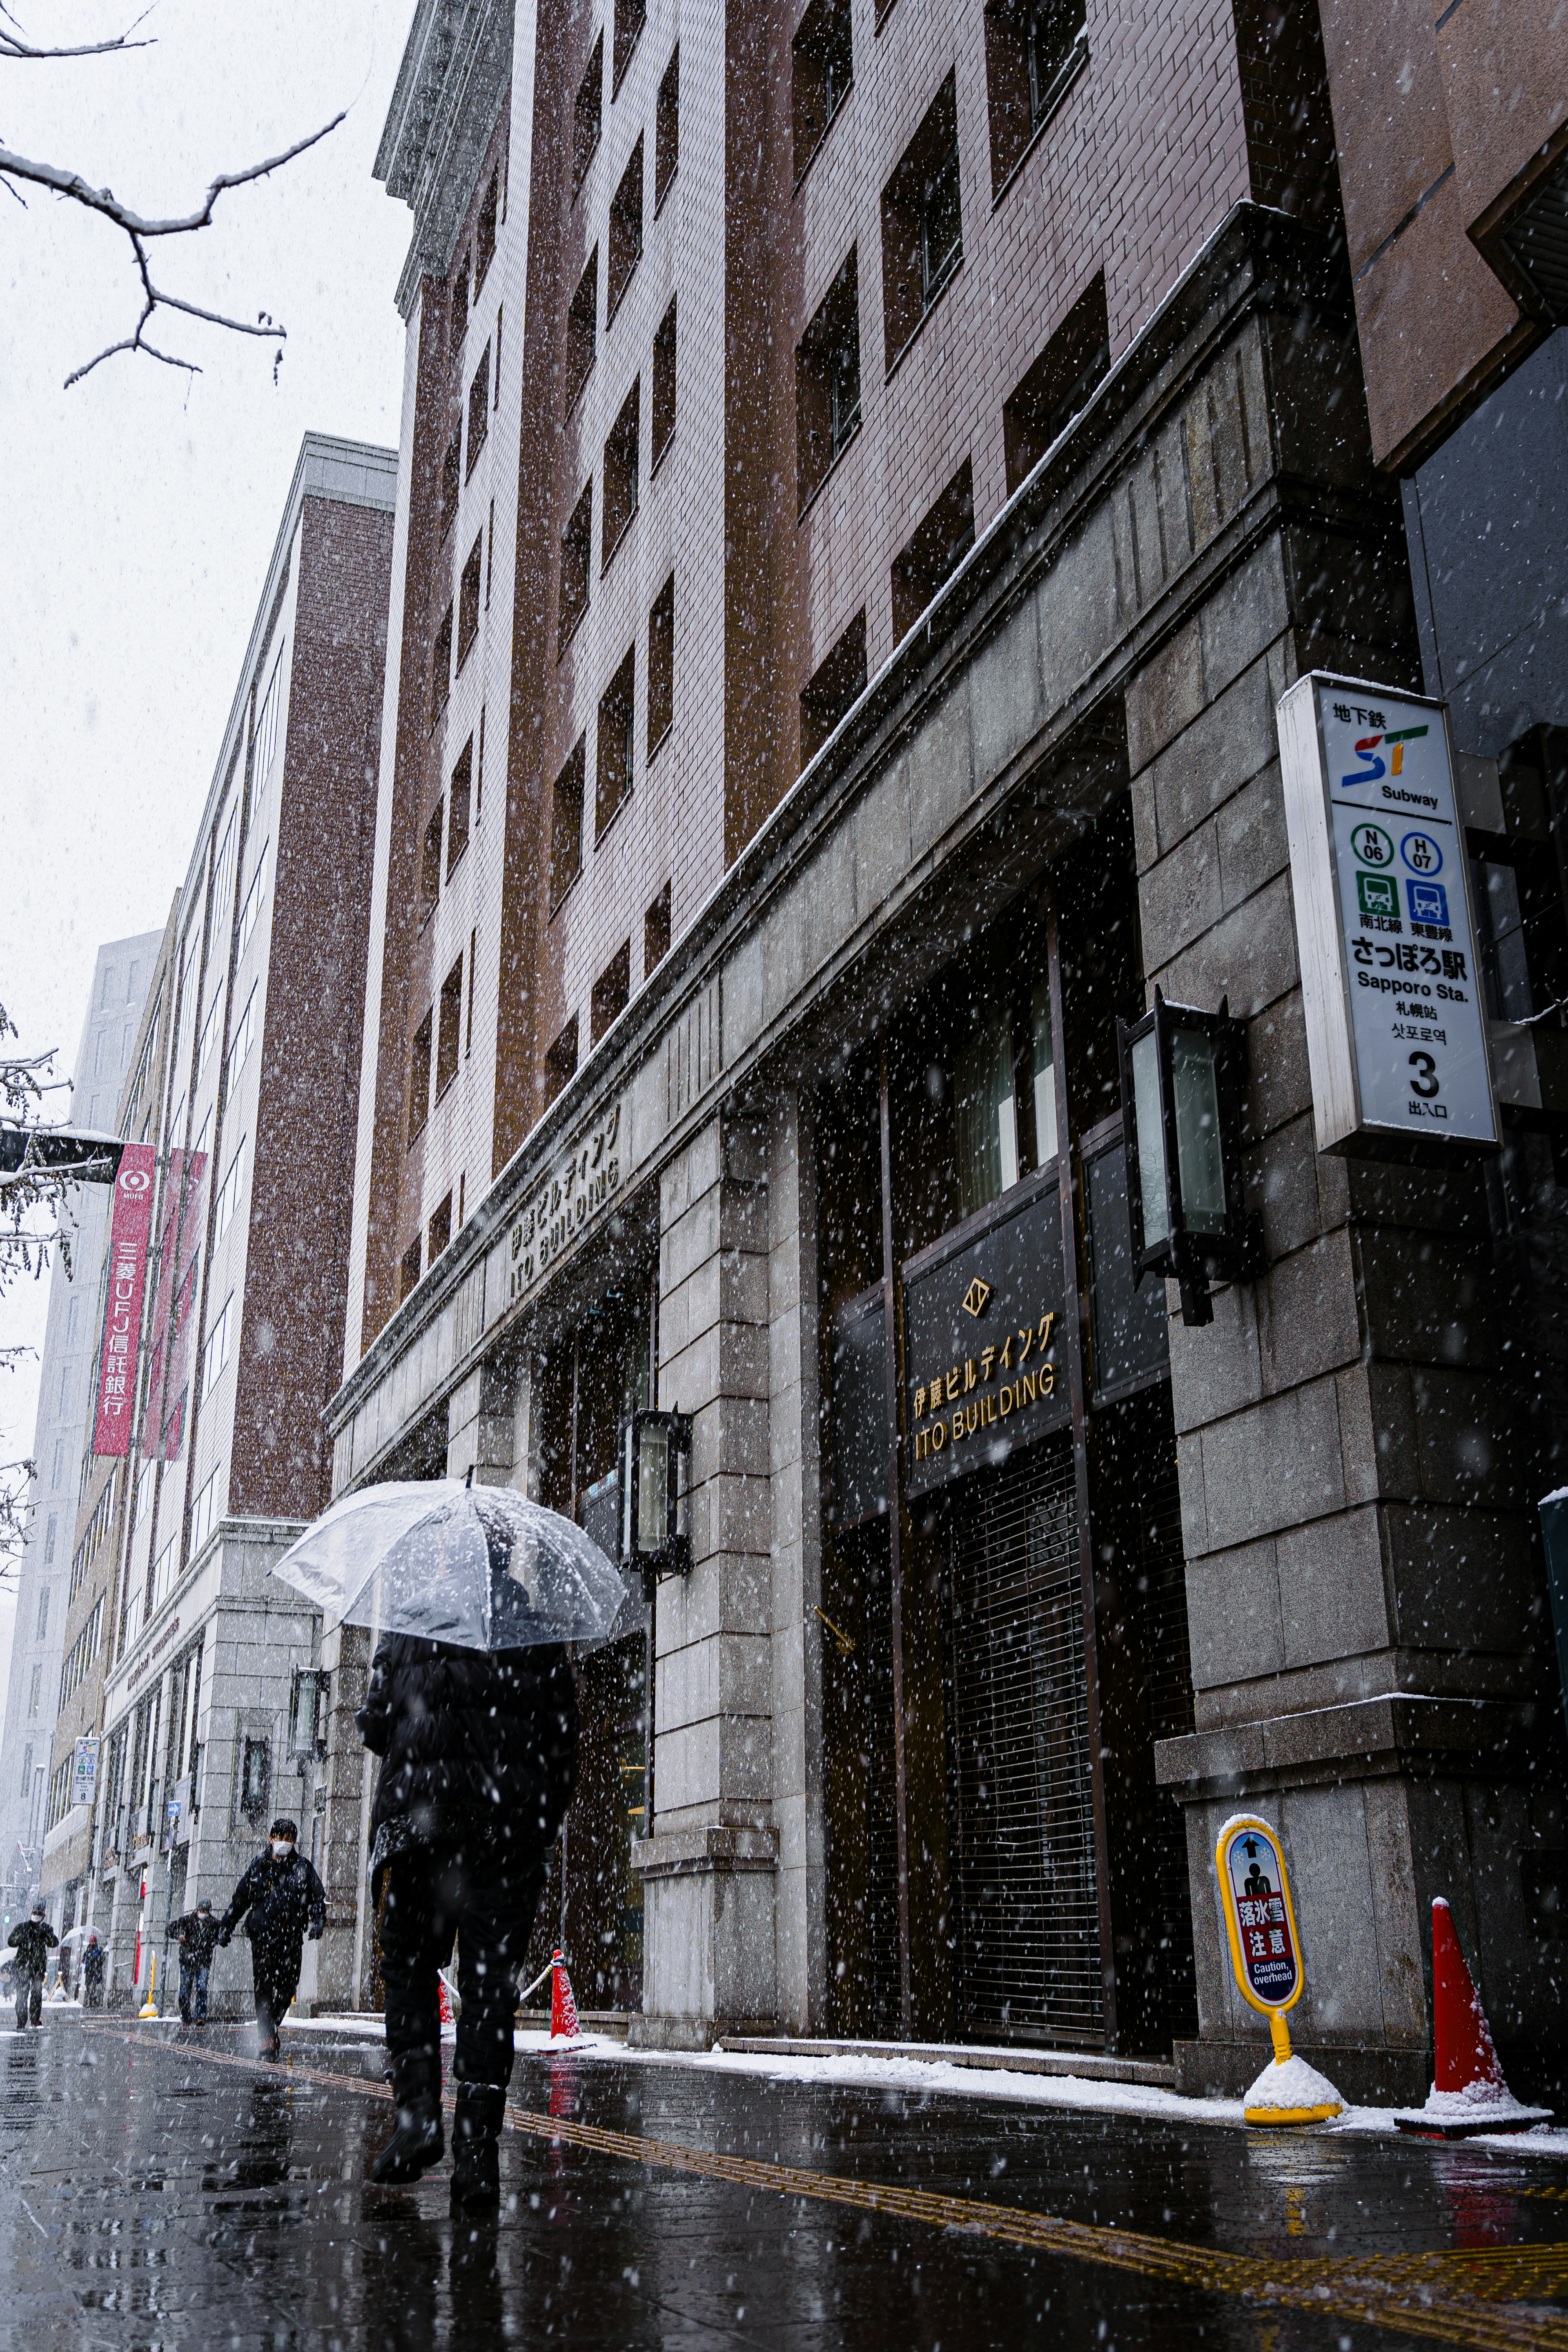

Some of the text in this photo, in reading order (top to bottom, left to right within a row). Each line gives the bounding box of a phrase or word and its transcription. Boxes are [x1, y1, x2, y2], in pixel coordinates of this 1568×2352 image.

[1332, 703, 1387, 730] 地下鉄
[1381, 785, 1438, 810] Subway
[1366, 830, 1377, 845] N
[1414, 839, 1427, 854] H
[1364, 845, 1383, 861] 06
[1413, 854, 1432, 870] 07
[1359, 914, 1403, 934] 南北線
[1410, 922, 1453, 942] 東豊線
[1352, 936, 1468, 981] さっぽろ駅
[1358, 971, 1468, 1002] Sapporo Sta.
[1396, 1001, 1437, 1021] 札幌站
[1391, 1023, 1447, 1045] 삿포로역
[1408, 1051, 1439, 1098] 3
[1409, 1101, 1448, 1119] 出入口
[510, 1157, 619, 1298] ITO BUILDING
[103, 1242, 138, 1416] 三菱UFJ信託銀行
[914, 1311, 1057, 1419] 伊藤ビルディング
[915, 1363, 1057, 1460] ITO BUILDING
[1238, 1897, 1285, 1927] 落氷雪
[1249, 1928, 1286, 1957] 注意
[1254, 1962, 1289, 1973] Caution,
[1254, 1970, 1293, 1985] overhead
